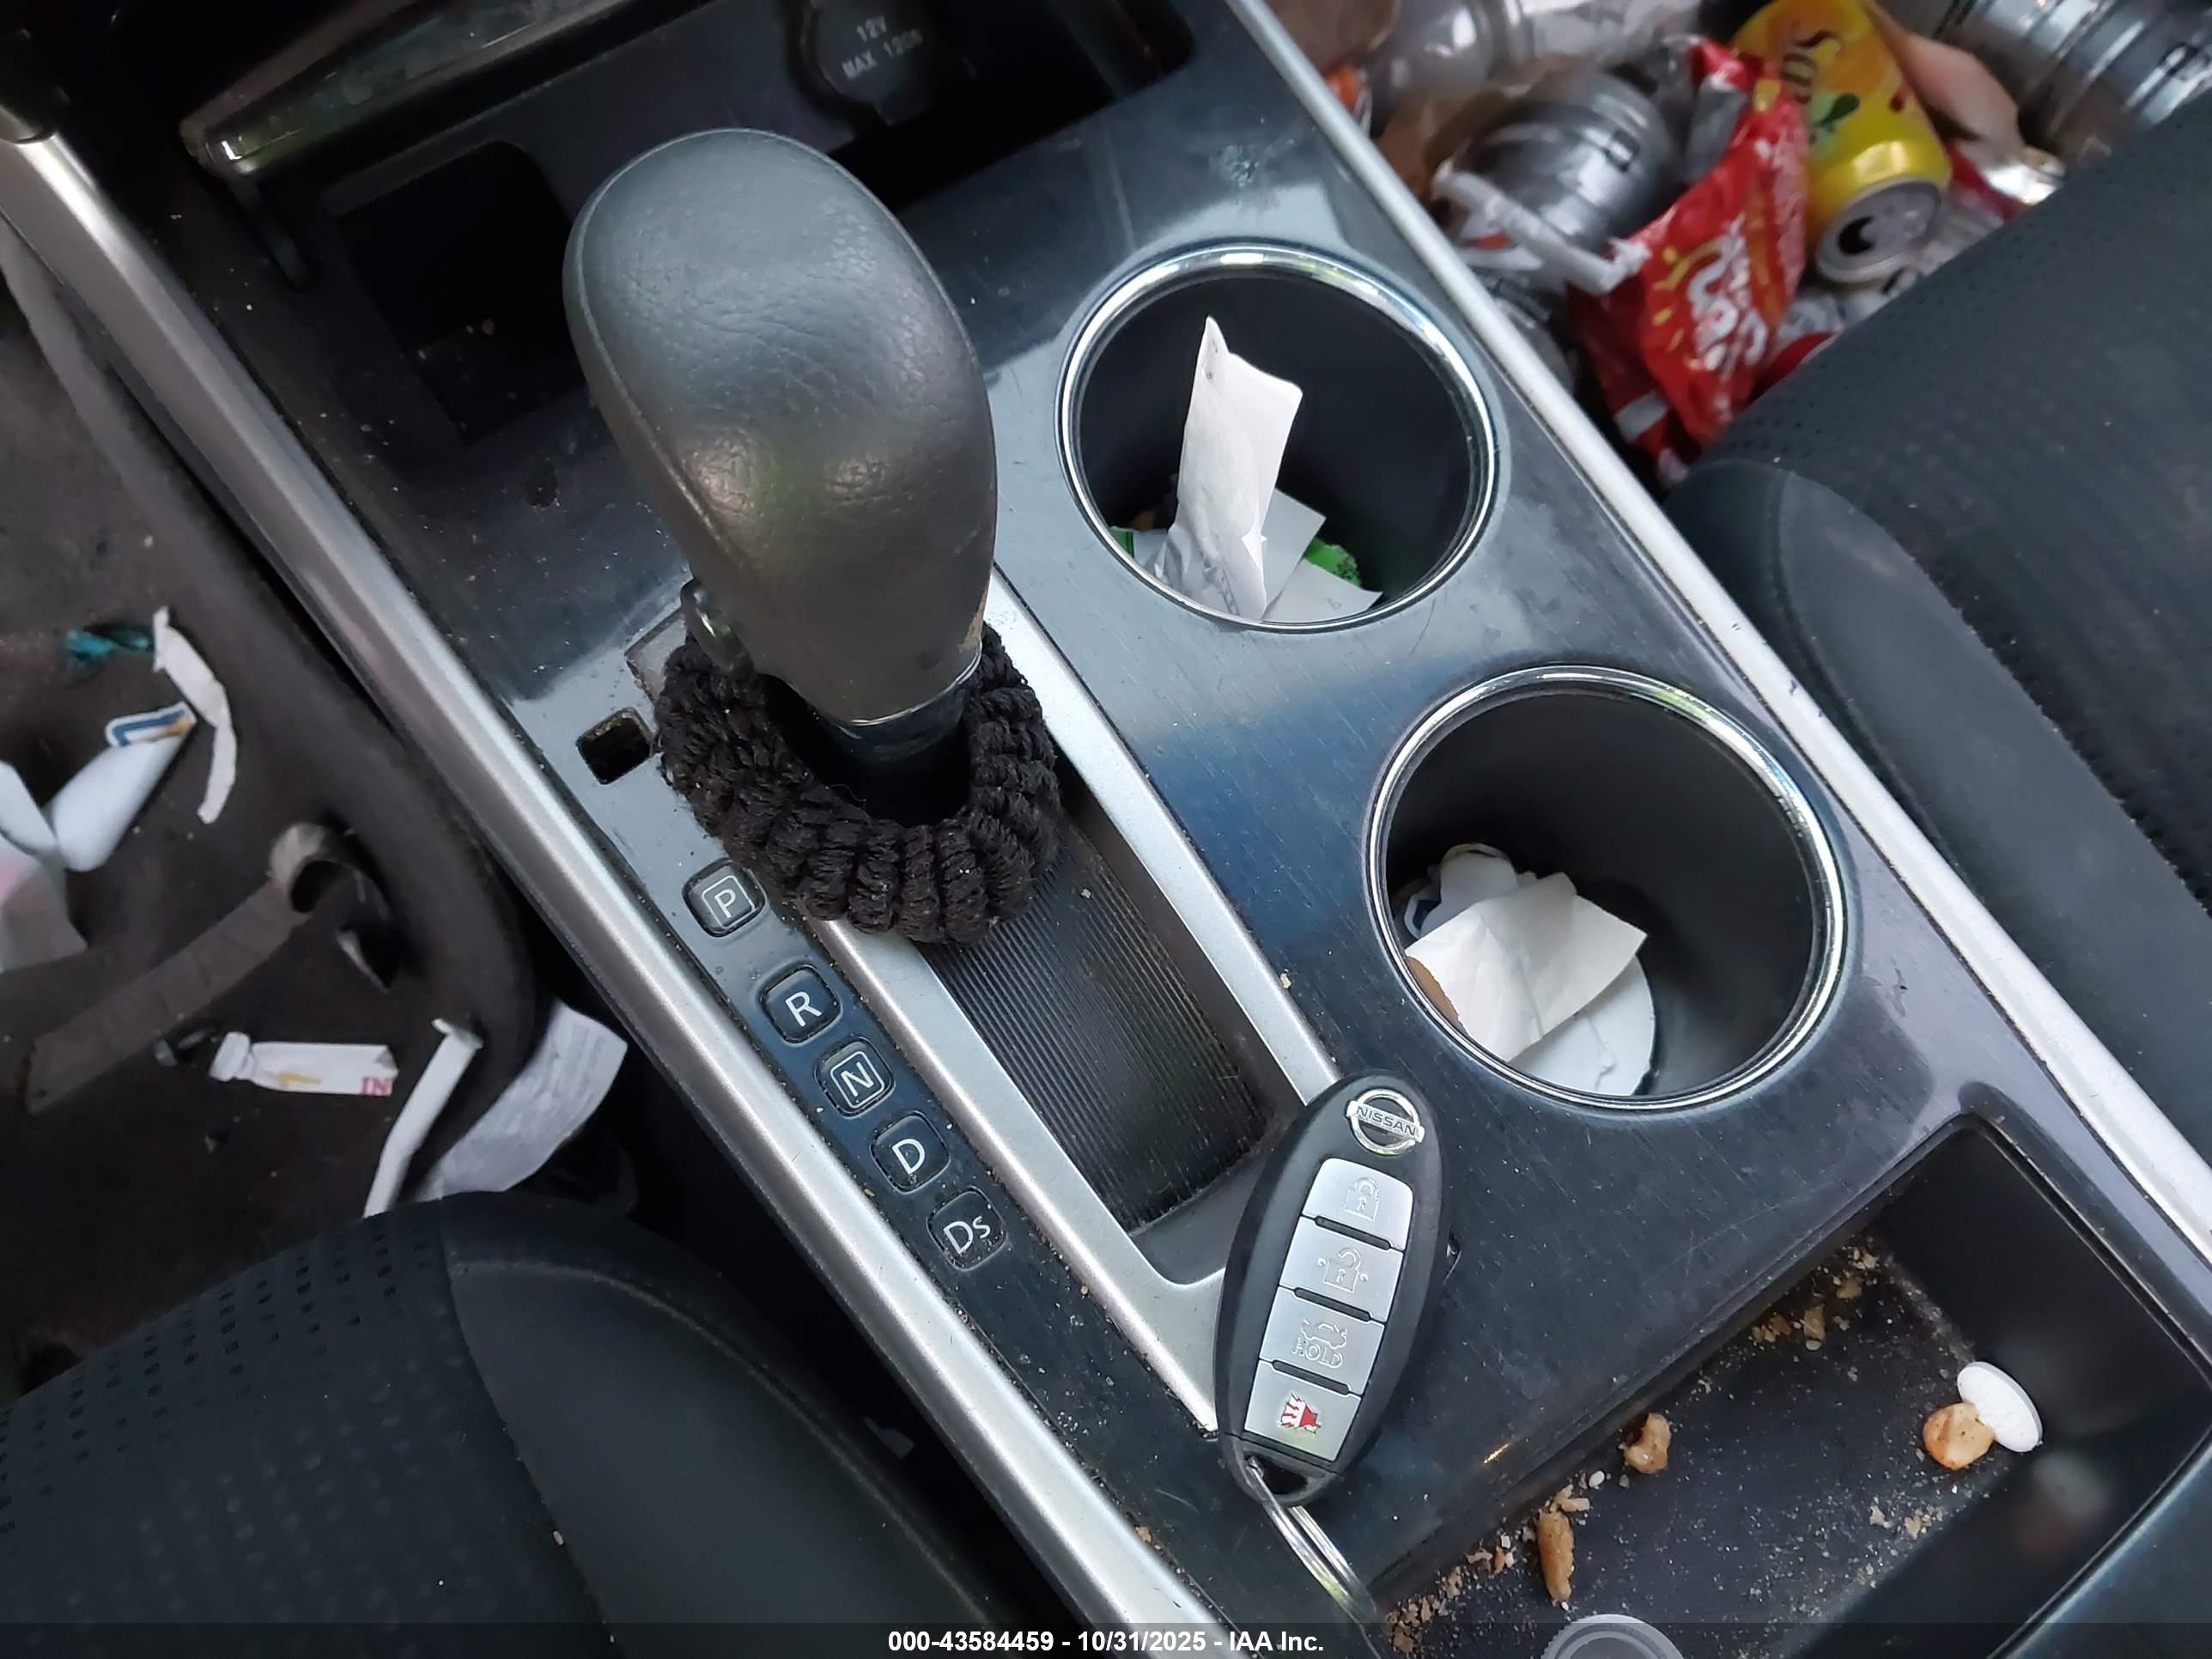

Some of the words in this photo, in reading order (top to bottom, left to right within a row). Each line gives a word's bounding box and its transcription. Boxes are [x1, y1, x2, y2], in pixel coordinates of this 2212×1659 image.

[714, 888, 737, 919] P
[785, 990, 822, 1027] R
[840, 1061, 873, 1097] N
[1357, 1106, 1416, 1136] NISSAN
[891, 1139, 925, 1176] D
[1291, 1337, 1343, 1369] HOLD
